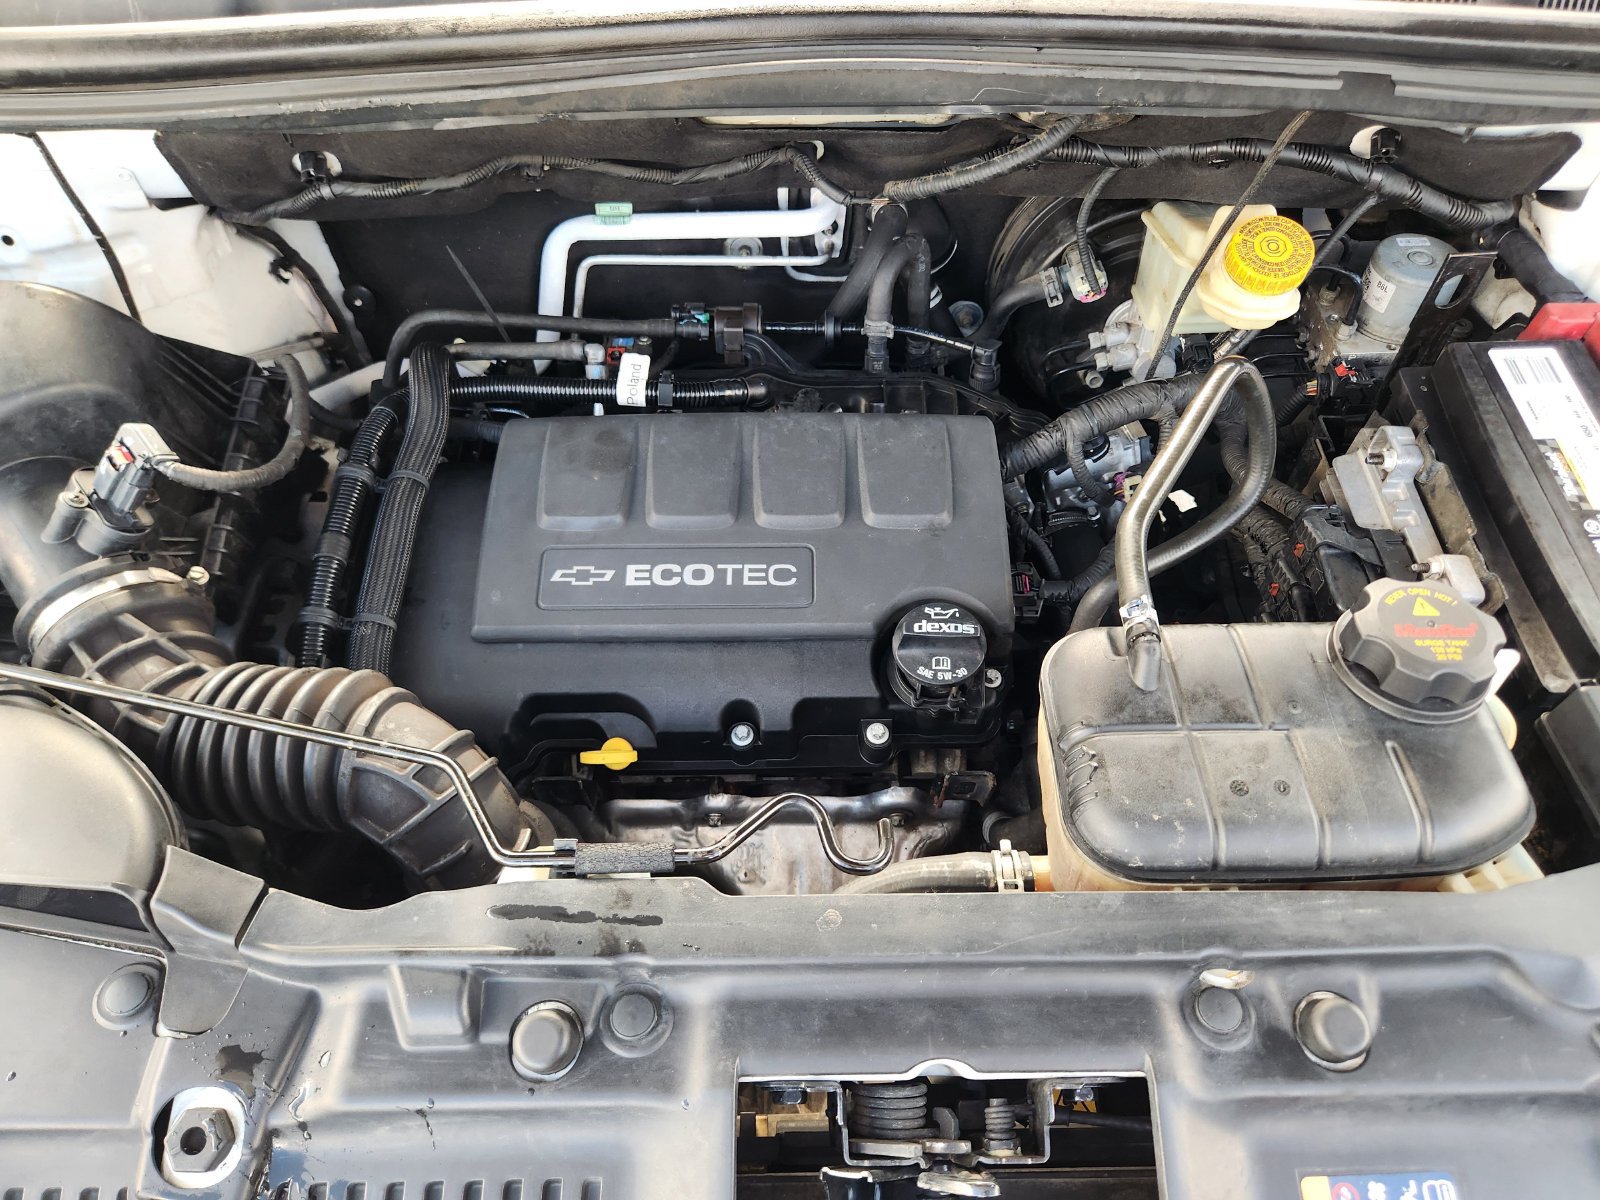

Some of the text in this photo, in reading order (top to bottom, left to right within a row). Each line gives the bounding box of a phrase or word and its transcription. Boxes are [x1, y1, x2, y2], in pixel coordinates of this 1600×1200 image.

[626, 363, 642, 405] Poland
[625, 563, 798, 587] ECOTEC
[913, 619, 975, 634] dexos
[917, 666, 968, 680] SAE 5W-30
